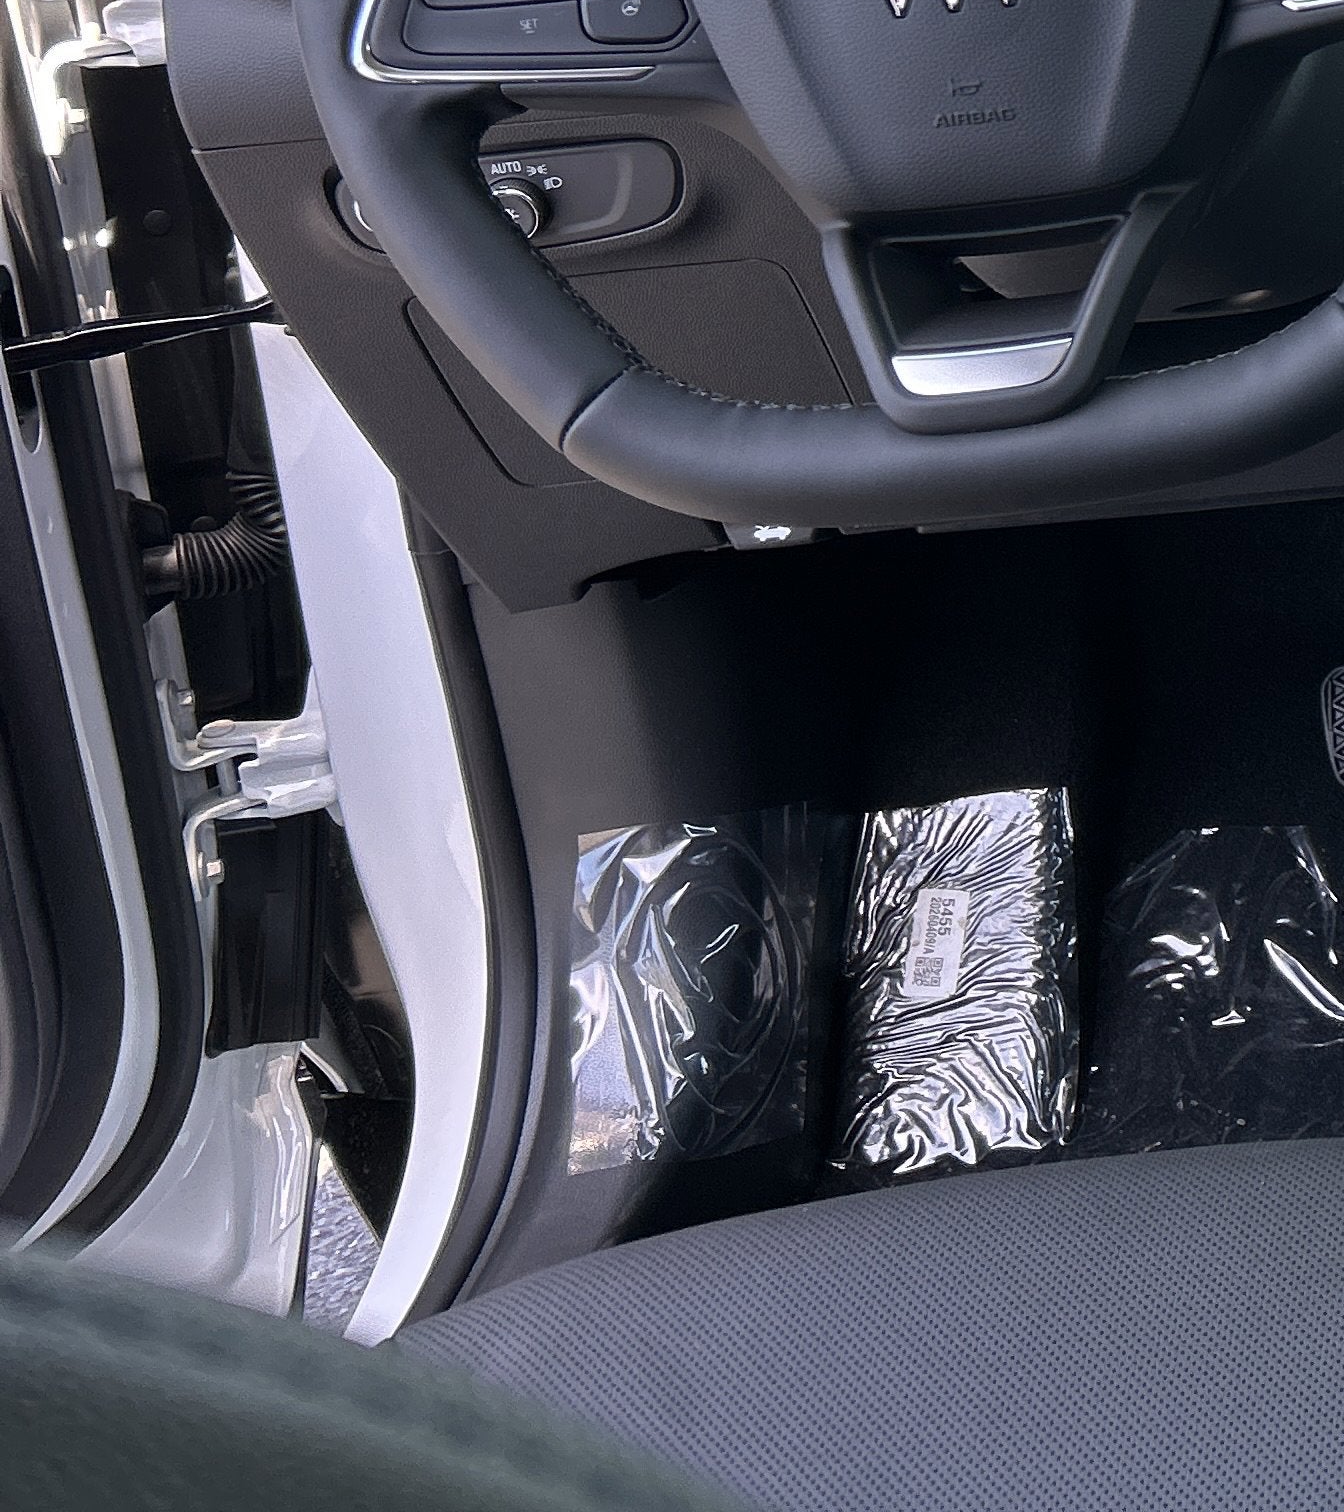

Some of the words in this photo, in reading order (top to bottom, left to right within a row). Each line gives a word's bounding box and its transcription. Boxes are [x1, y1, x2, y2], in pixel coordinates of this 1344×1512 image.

[519, 18, 538, 31] SET
[934, 108, 1017, 129] AIRBAG
[489, 159, 523, 176] AUTO
[923, 896, 941, 955] 20260409/A
[938, 898, 956, 936] 5455
